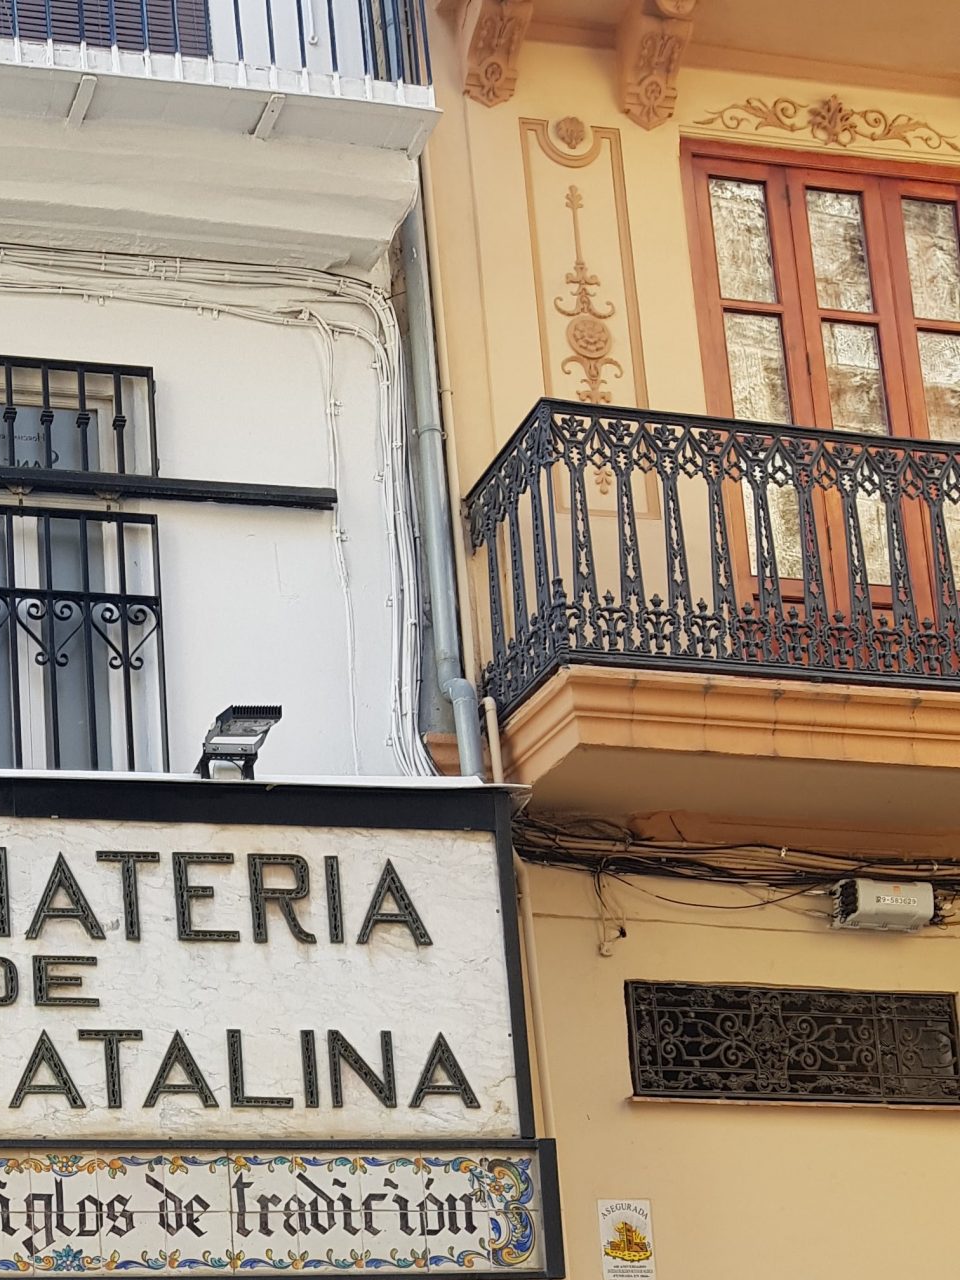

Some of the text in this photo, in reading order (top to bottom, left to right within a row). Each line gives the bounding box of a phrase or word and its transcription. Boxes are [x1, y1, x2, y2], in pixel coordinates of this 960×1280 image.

[145, 1173, 211, 1238] de
[230, 1172, 477, 1238] tradición
[601, 1203, 648, 1220] ASEGURADA
